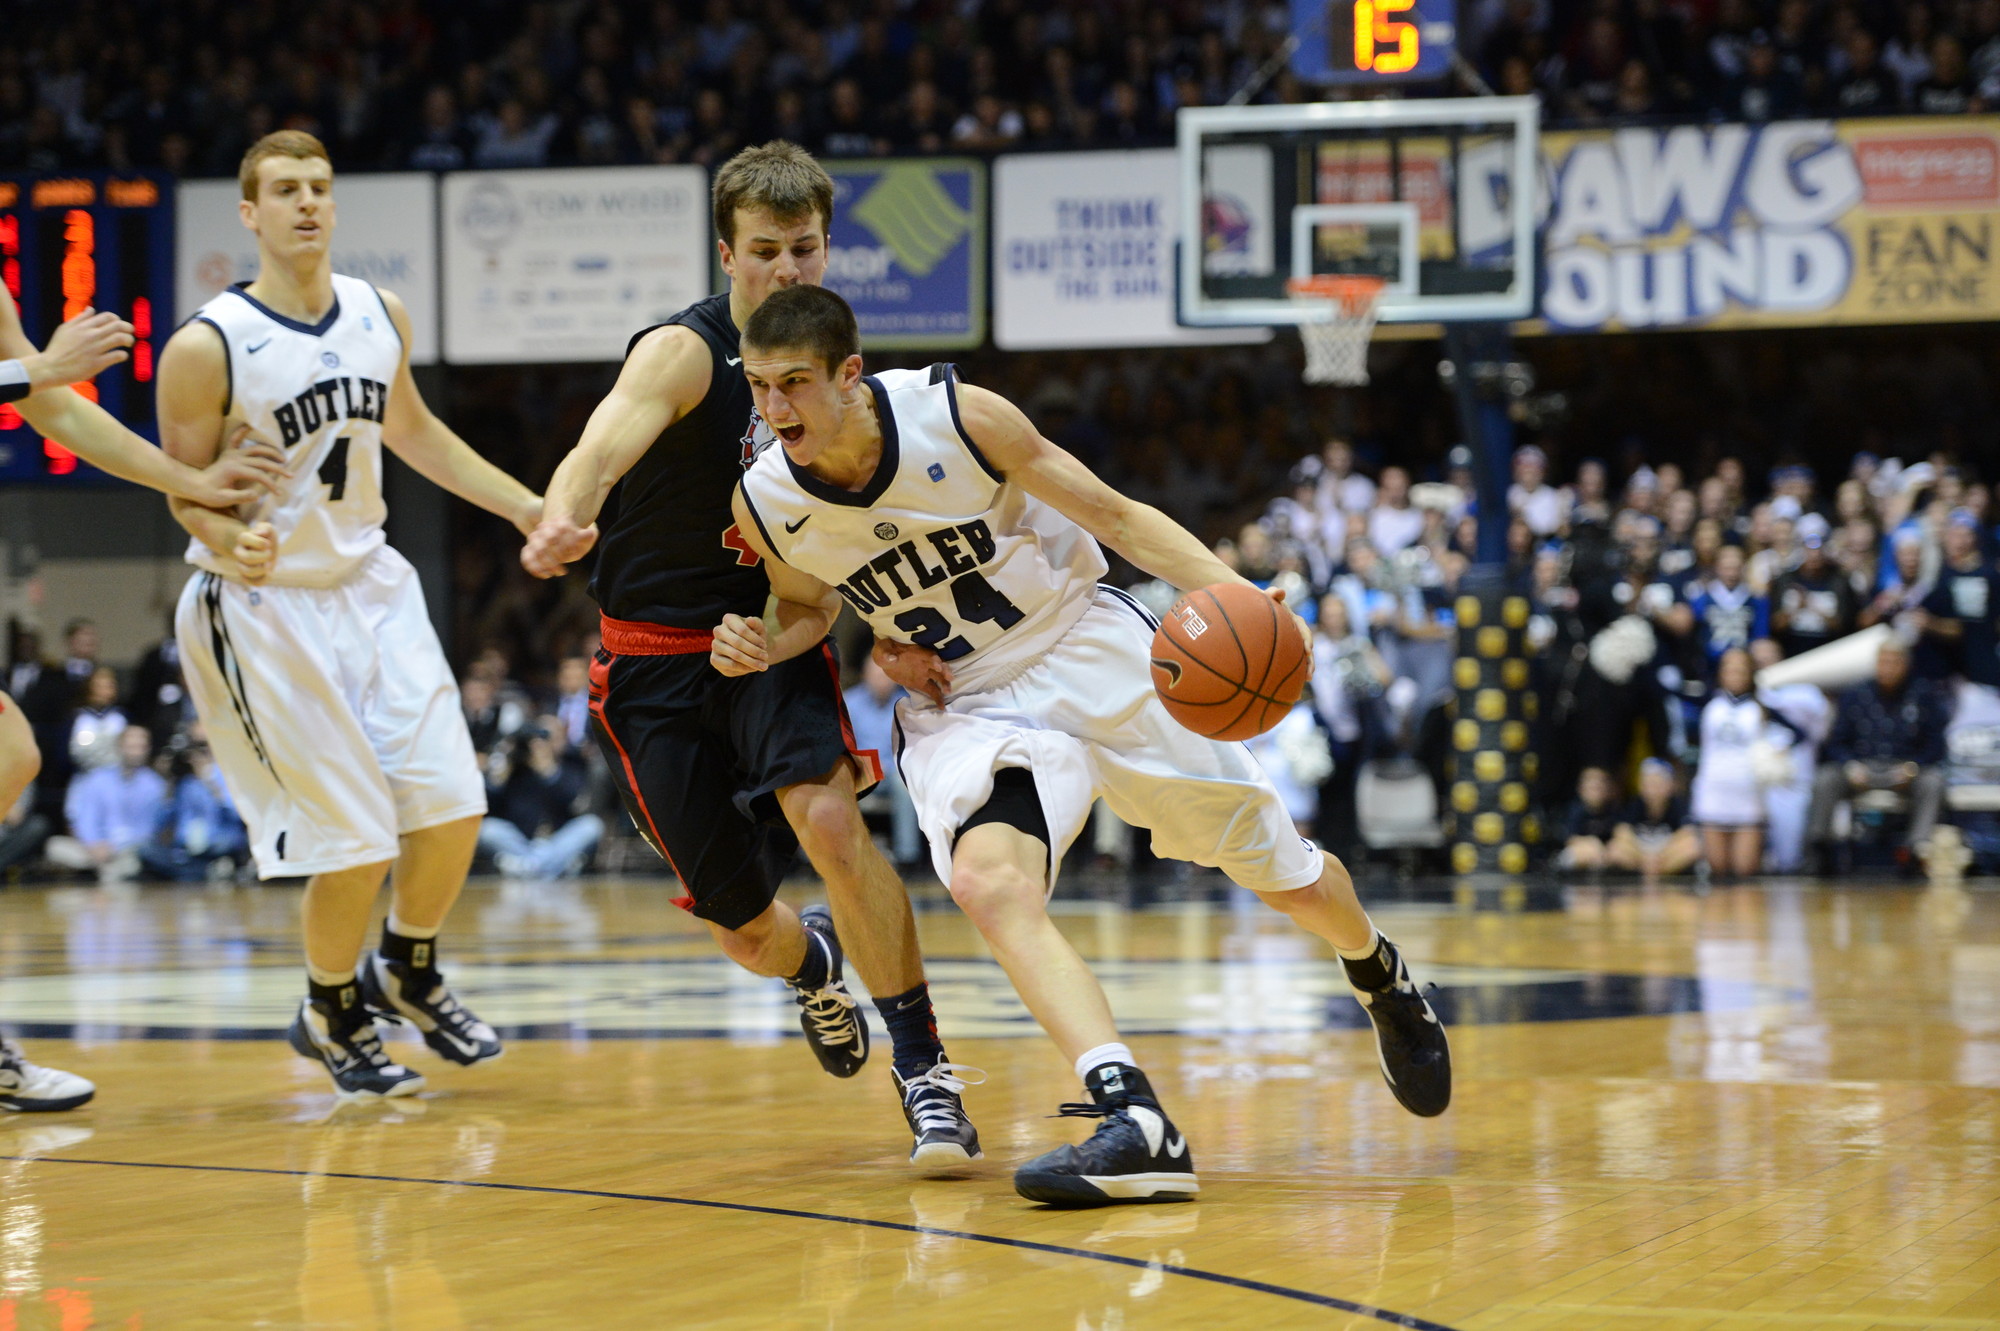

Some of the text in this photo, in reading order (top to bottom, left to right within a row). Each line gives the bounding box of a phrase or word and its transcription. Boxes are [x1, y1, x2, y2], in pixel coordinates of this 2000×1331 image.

[1354, 0, 1420, 74] 15
[1057, 198, 1160, 230] THINK
[1458, 119, 1866, 262] DAWG
[1007, 237, 1158, 273] OUTSIDE
[1543, 226, 1853, 328] OUND
[1867, 216, 1991, 275] FAN
[1870, 271, 1986, 309] ZONE
[317, 437, 351, 501] 4
[893, 570, 1027, 662] 24
